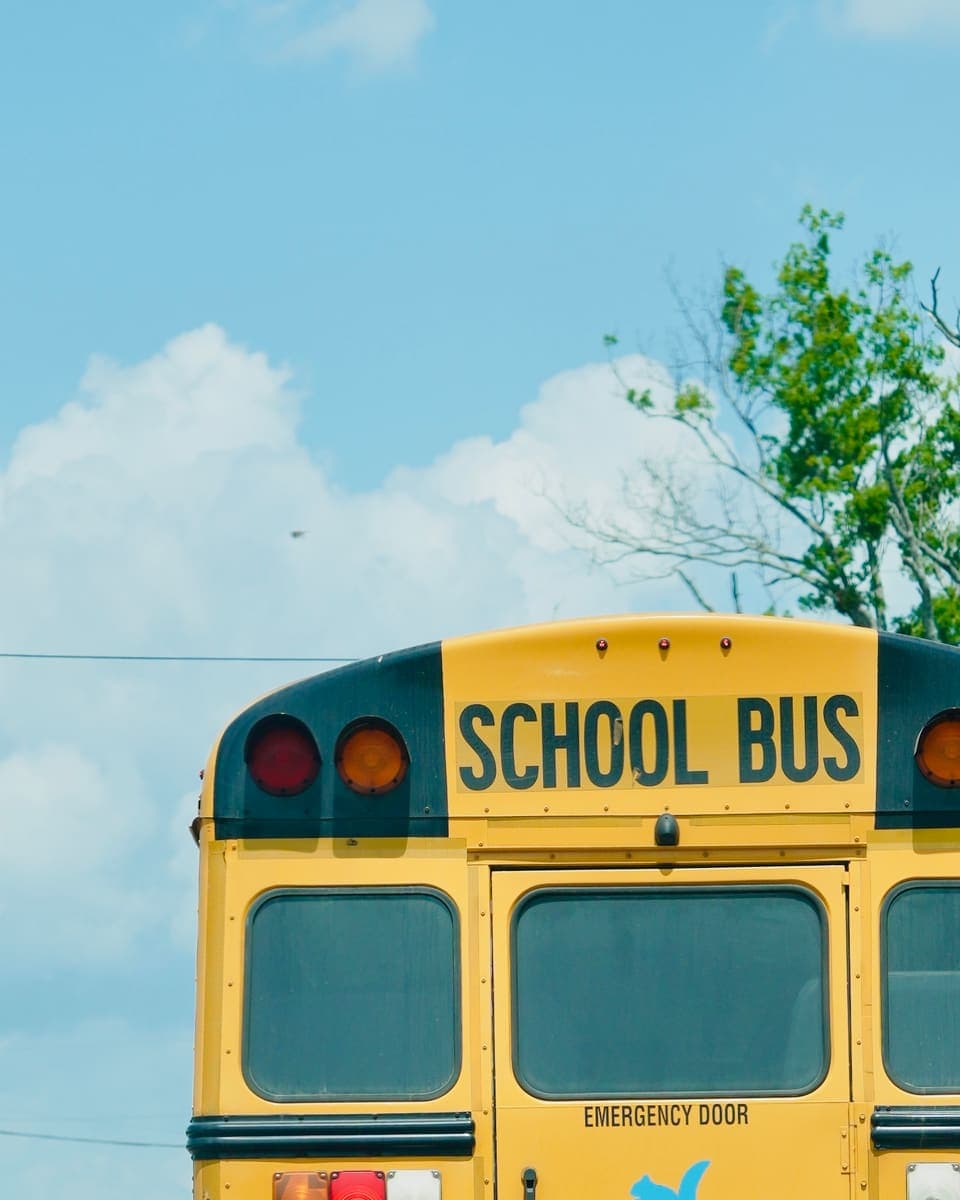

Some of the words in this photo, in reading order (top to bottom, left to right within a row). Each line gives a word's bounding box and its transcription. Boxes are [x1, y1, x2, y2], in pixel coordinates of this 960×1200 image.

[459, 699, 709, 791] SCHOOL
[738, 694, 861, 783] BUS
[584, 1105, 692, 1127] EMERGENCY
[700, 1104, 749, 1125] DOOR
